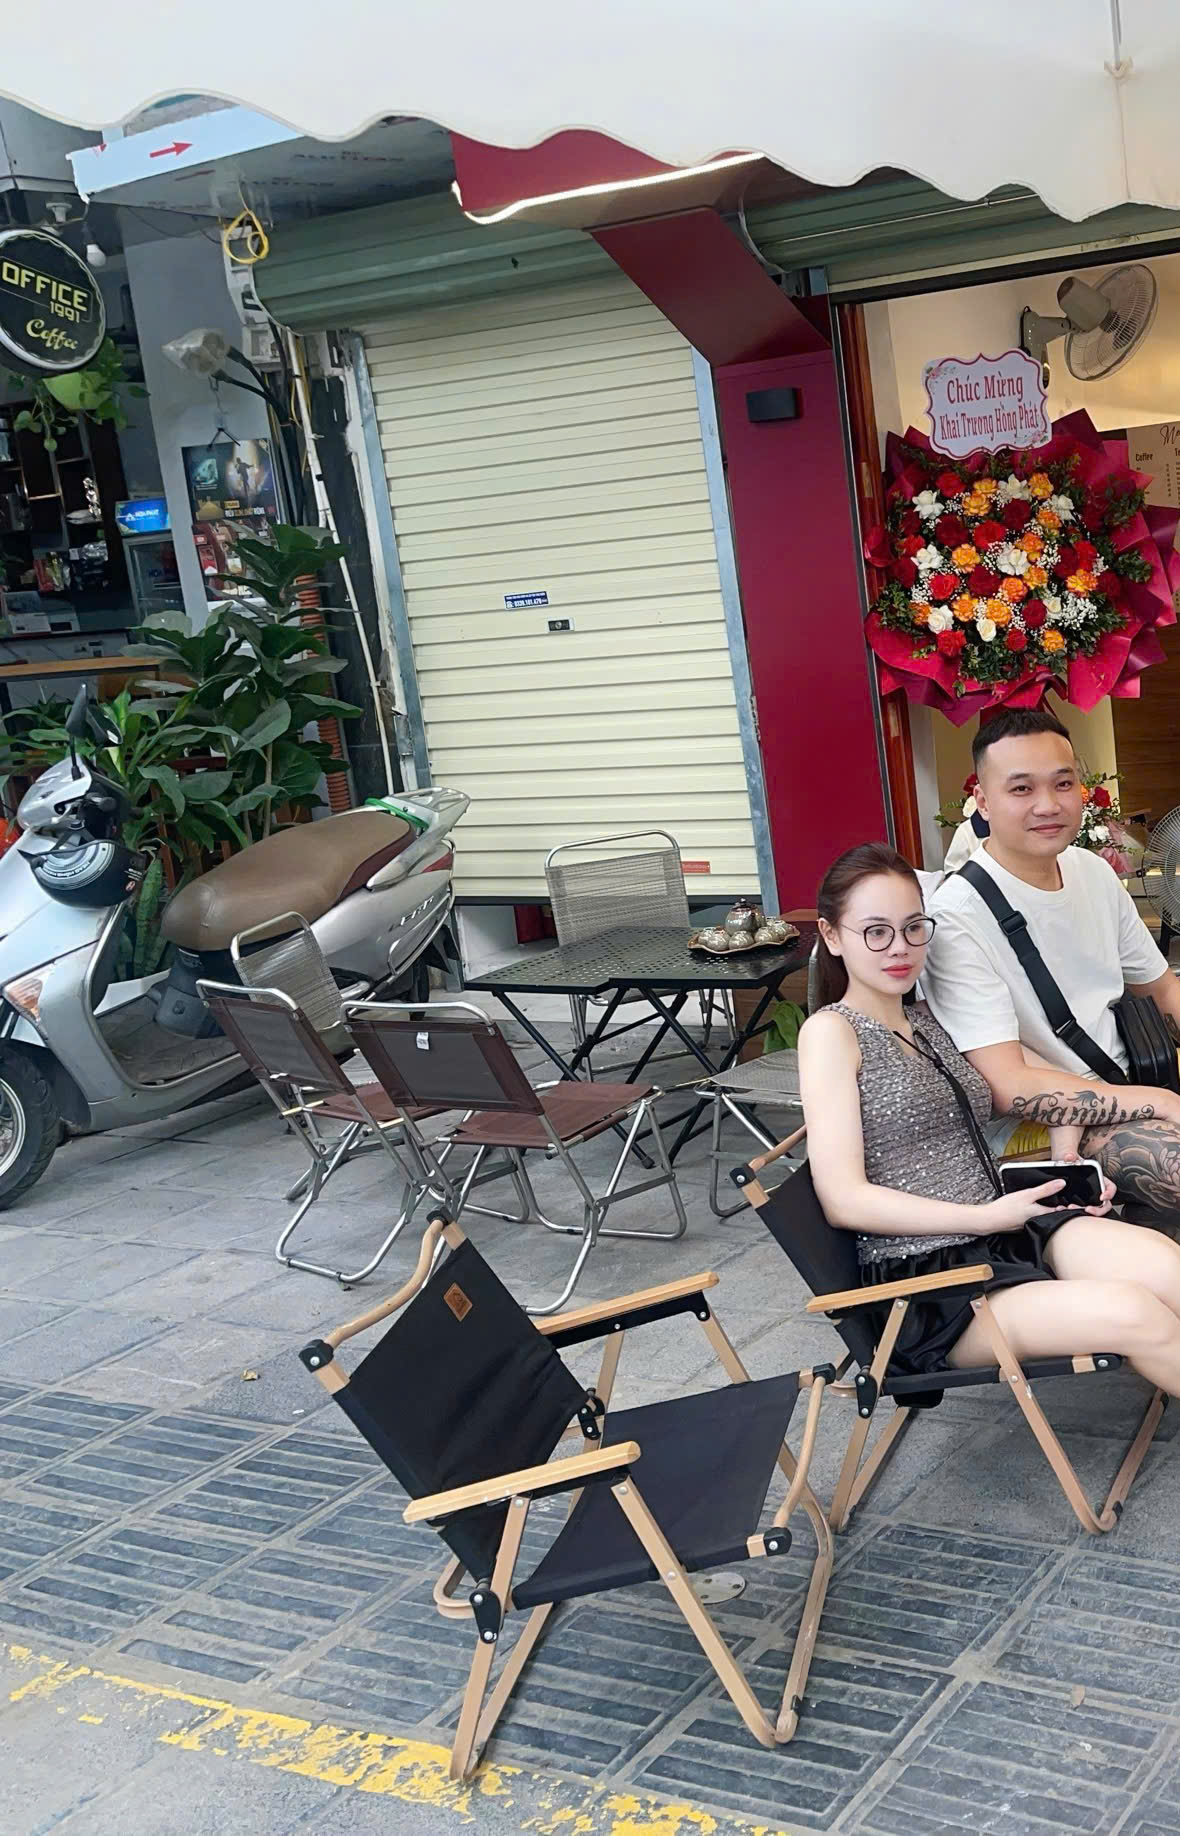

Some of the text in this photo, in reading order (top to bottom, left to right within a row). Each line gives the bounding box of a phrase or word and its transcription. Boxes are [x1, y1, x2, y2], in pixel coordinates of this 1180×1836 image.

[2, 261, 88, 312] OFFICE
[50, 301, 80, 323] 1991
[26, 319, 79, 350] Coffee
[946, 371, 1023, 404] Chúc Mừng
[939, 411, 961, 441] Khai
[1018, 401, 1039, 430] Phát
[1135, 453, 1154, 462] Coffee
[1009, 1090, 1155, 1126] Family
